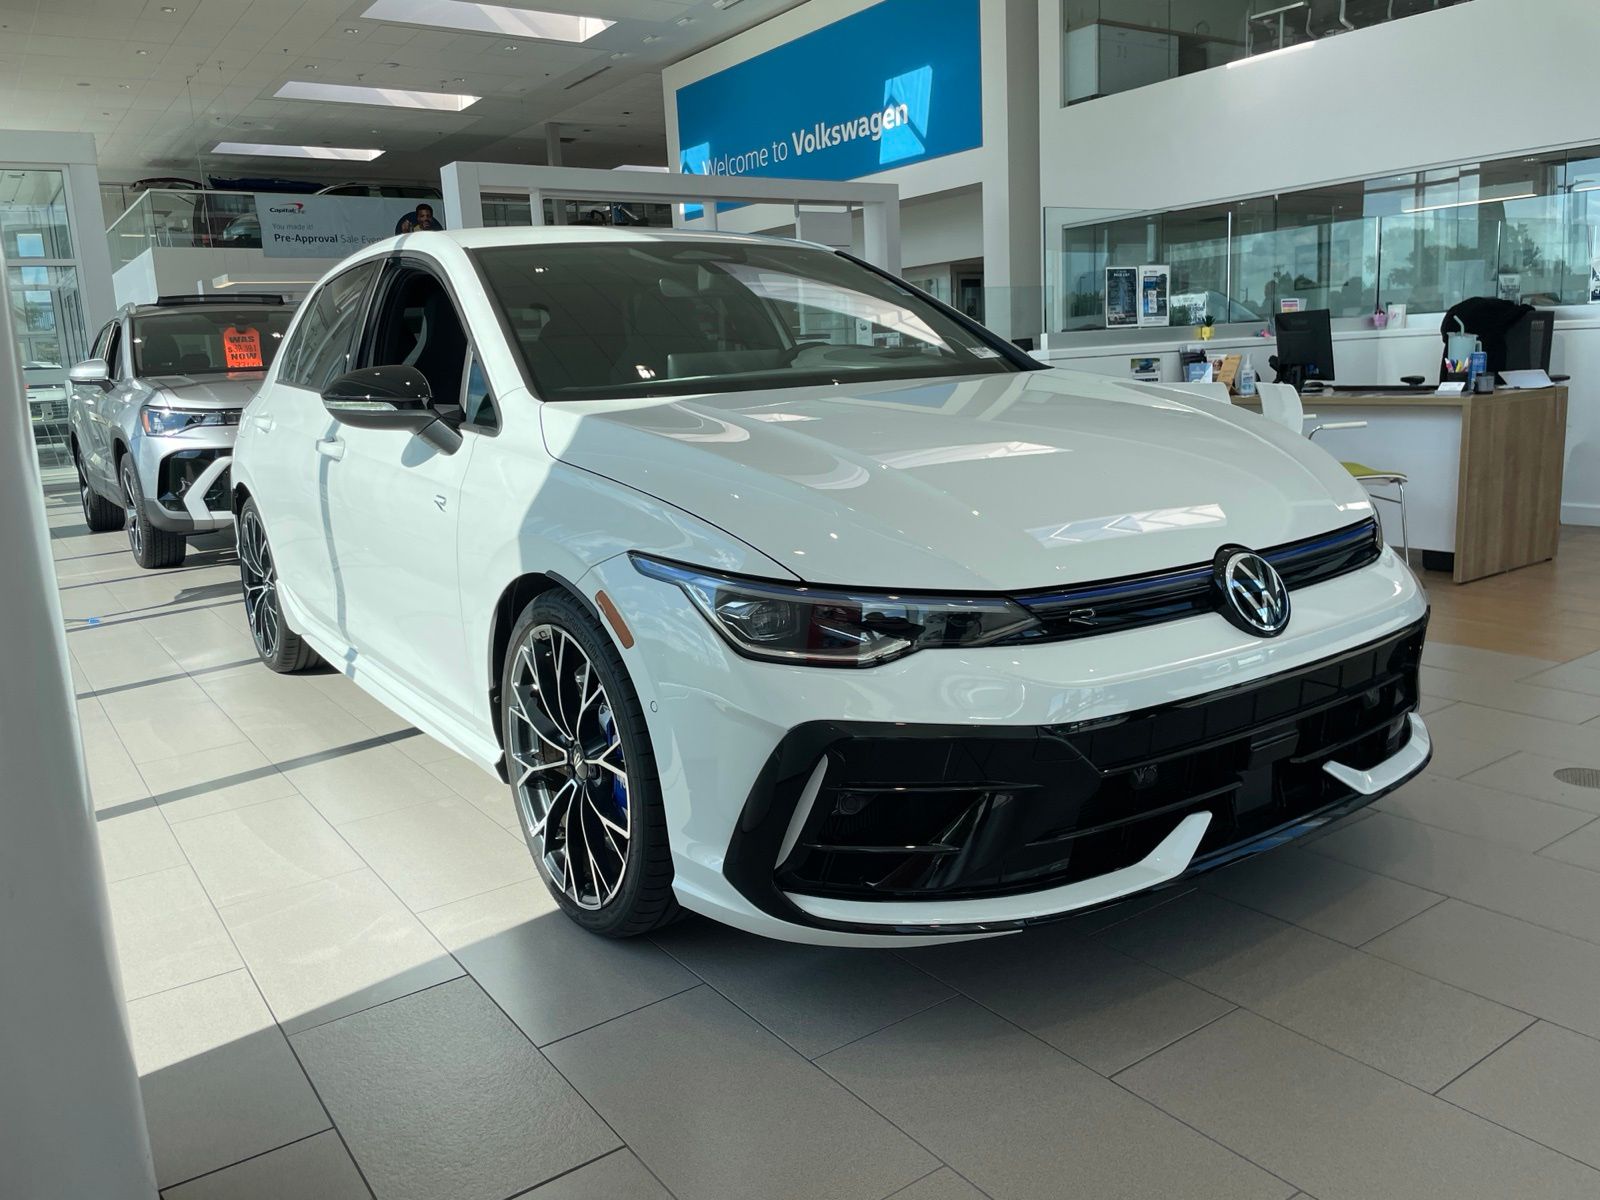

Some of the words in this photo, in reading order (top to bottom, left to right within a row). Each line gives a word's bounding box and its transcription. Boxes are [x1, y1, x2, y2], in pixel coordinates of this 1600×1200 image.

[702, 148, 768, 177] Welcome
[772, 141, 788, 163] to
[791, 102, 909, 156] Volkswagen
[286, 223, 305, 231] made
[274, 233, 338, 245] Pre-Approval
[341, 235, 359, 243] Sale
